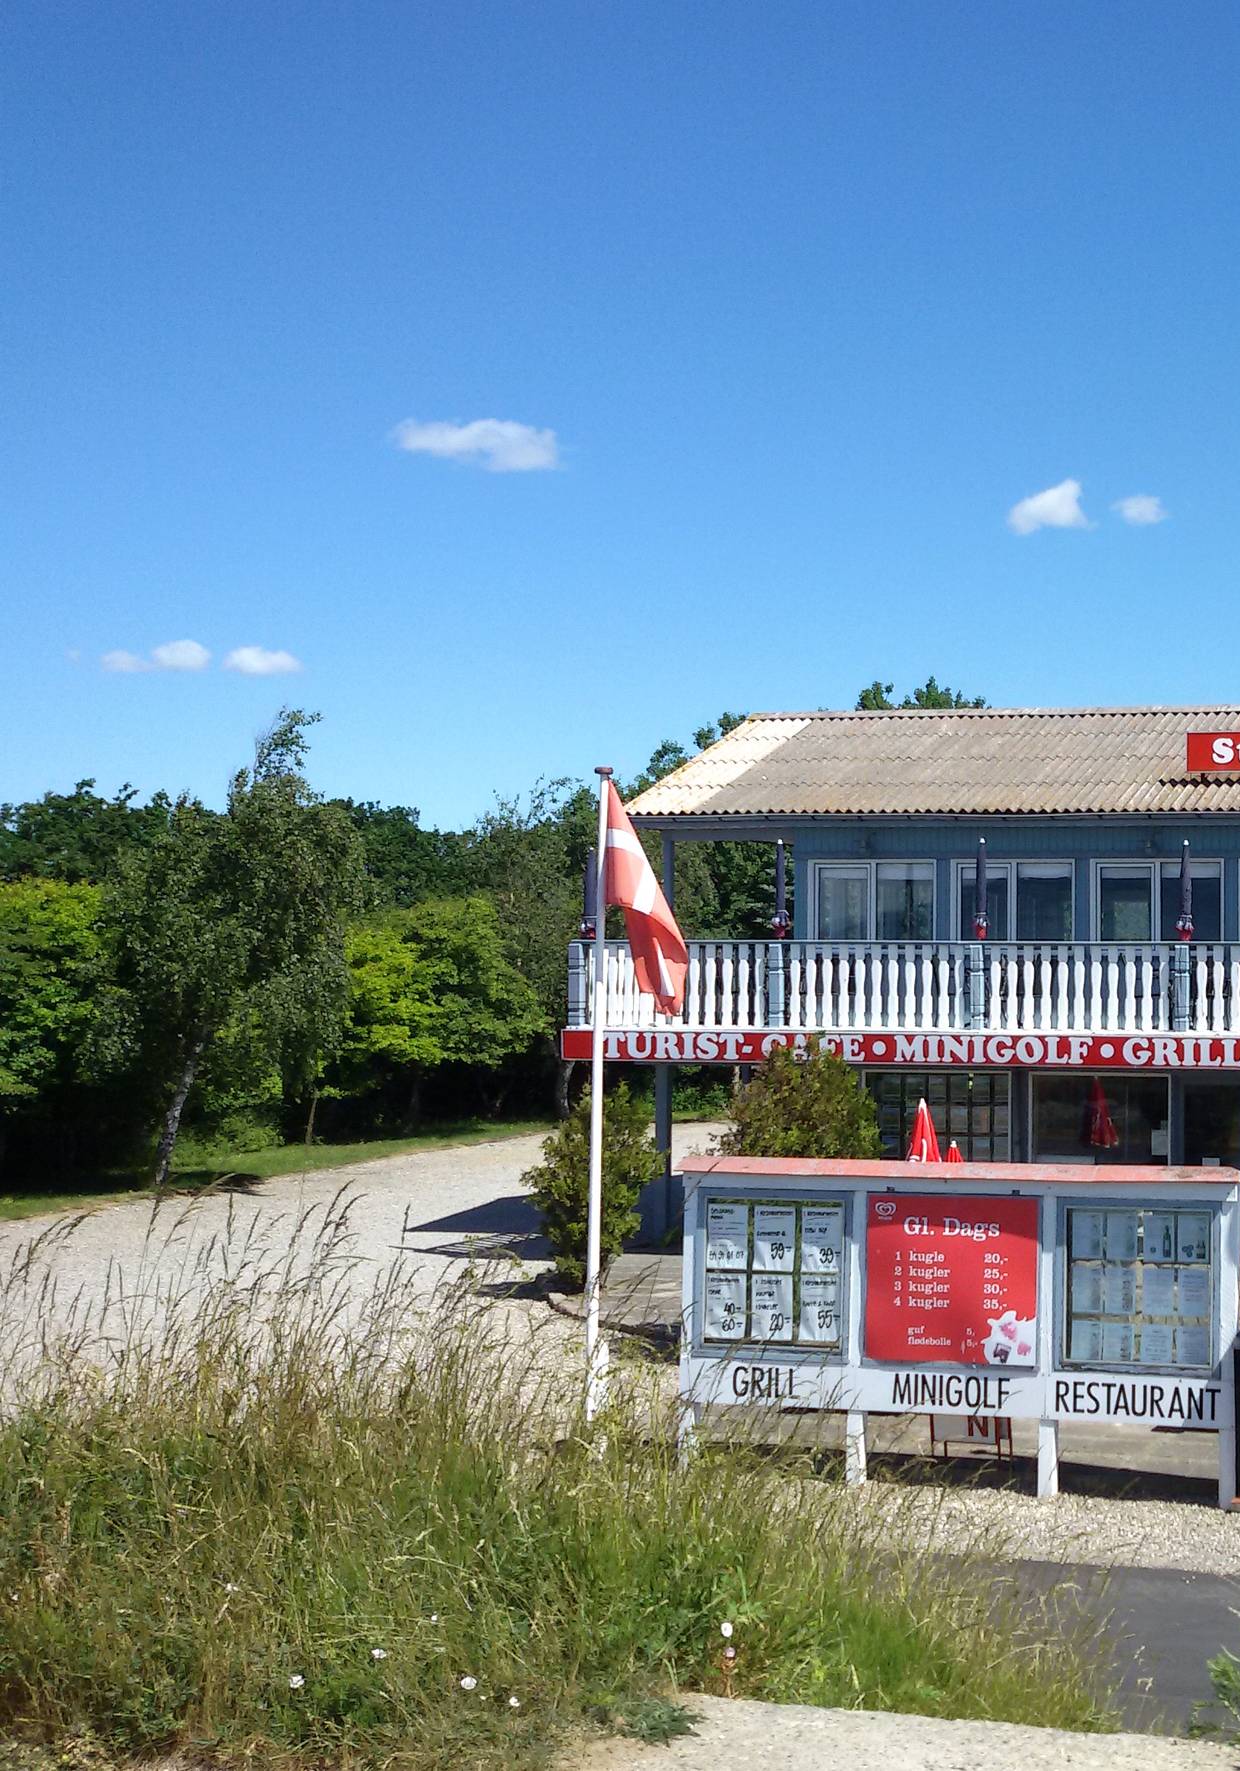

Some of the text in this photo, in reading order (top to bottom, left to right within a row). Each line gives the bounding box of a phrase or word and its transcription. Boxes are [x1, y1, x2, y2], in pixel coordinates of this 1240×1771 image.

[894, 1034, 1093, 1065] MINIGOLF
[903, 1216, 1000, 1242] Gl. Dags
[895, 1251, 1008, 1265] 1 kugle 20,-
[894, 1266, 1008, 1280] 2 kugler 25,-
[894, 1281, 1008, 1295] 3 kugler 30,-
[893, 1296, 1007, 1311] 4 kugler 35,-
[907, 1325, 925, 1335] guf
[907, 1336, 952, 1346] flødebolle
[732, 1366, 799, 1399] GRILL
[892, 1374, 1011, 1409] MINIGOLF
[1055, 1380, 1221, 1422] RESTAURANT
